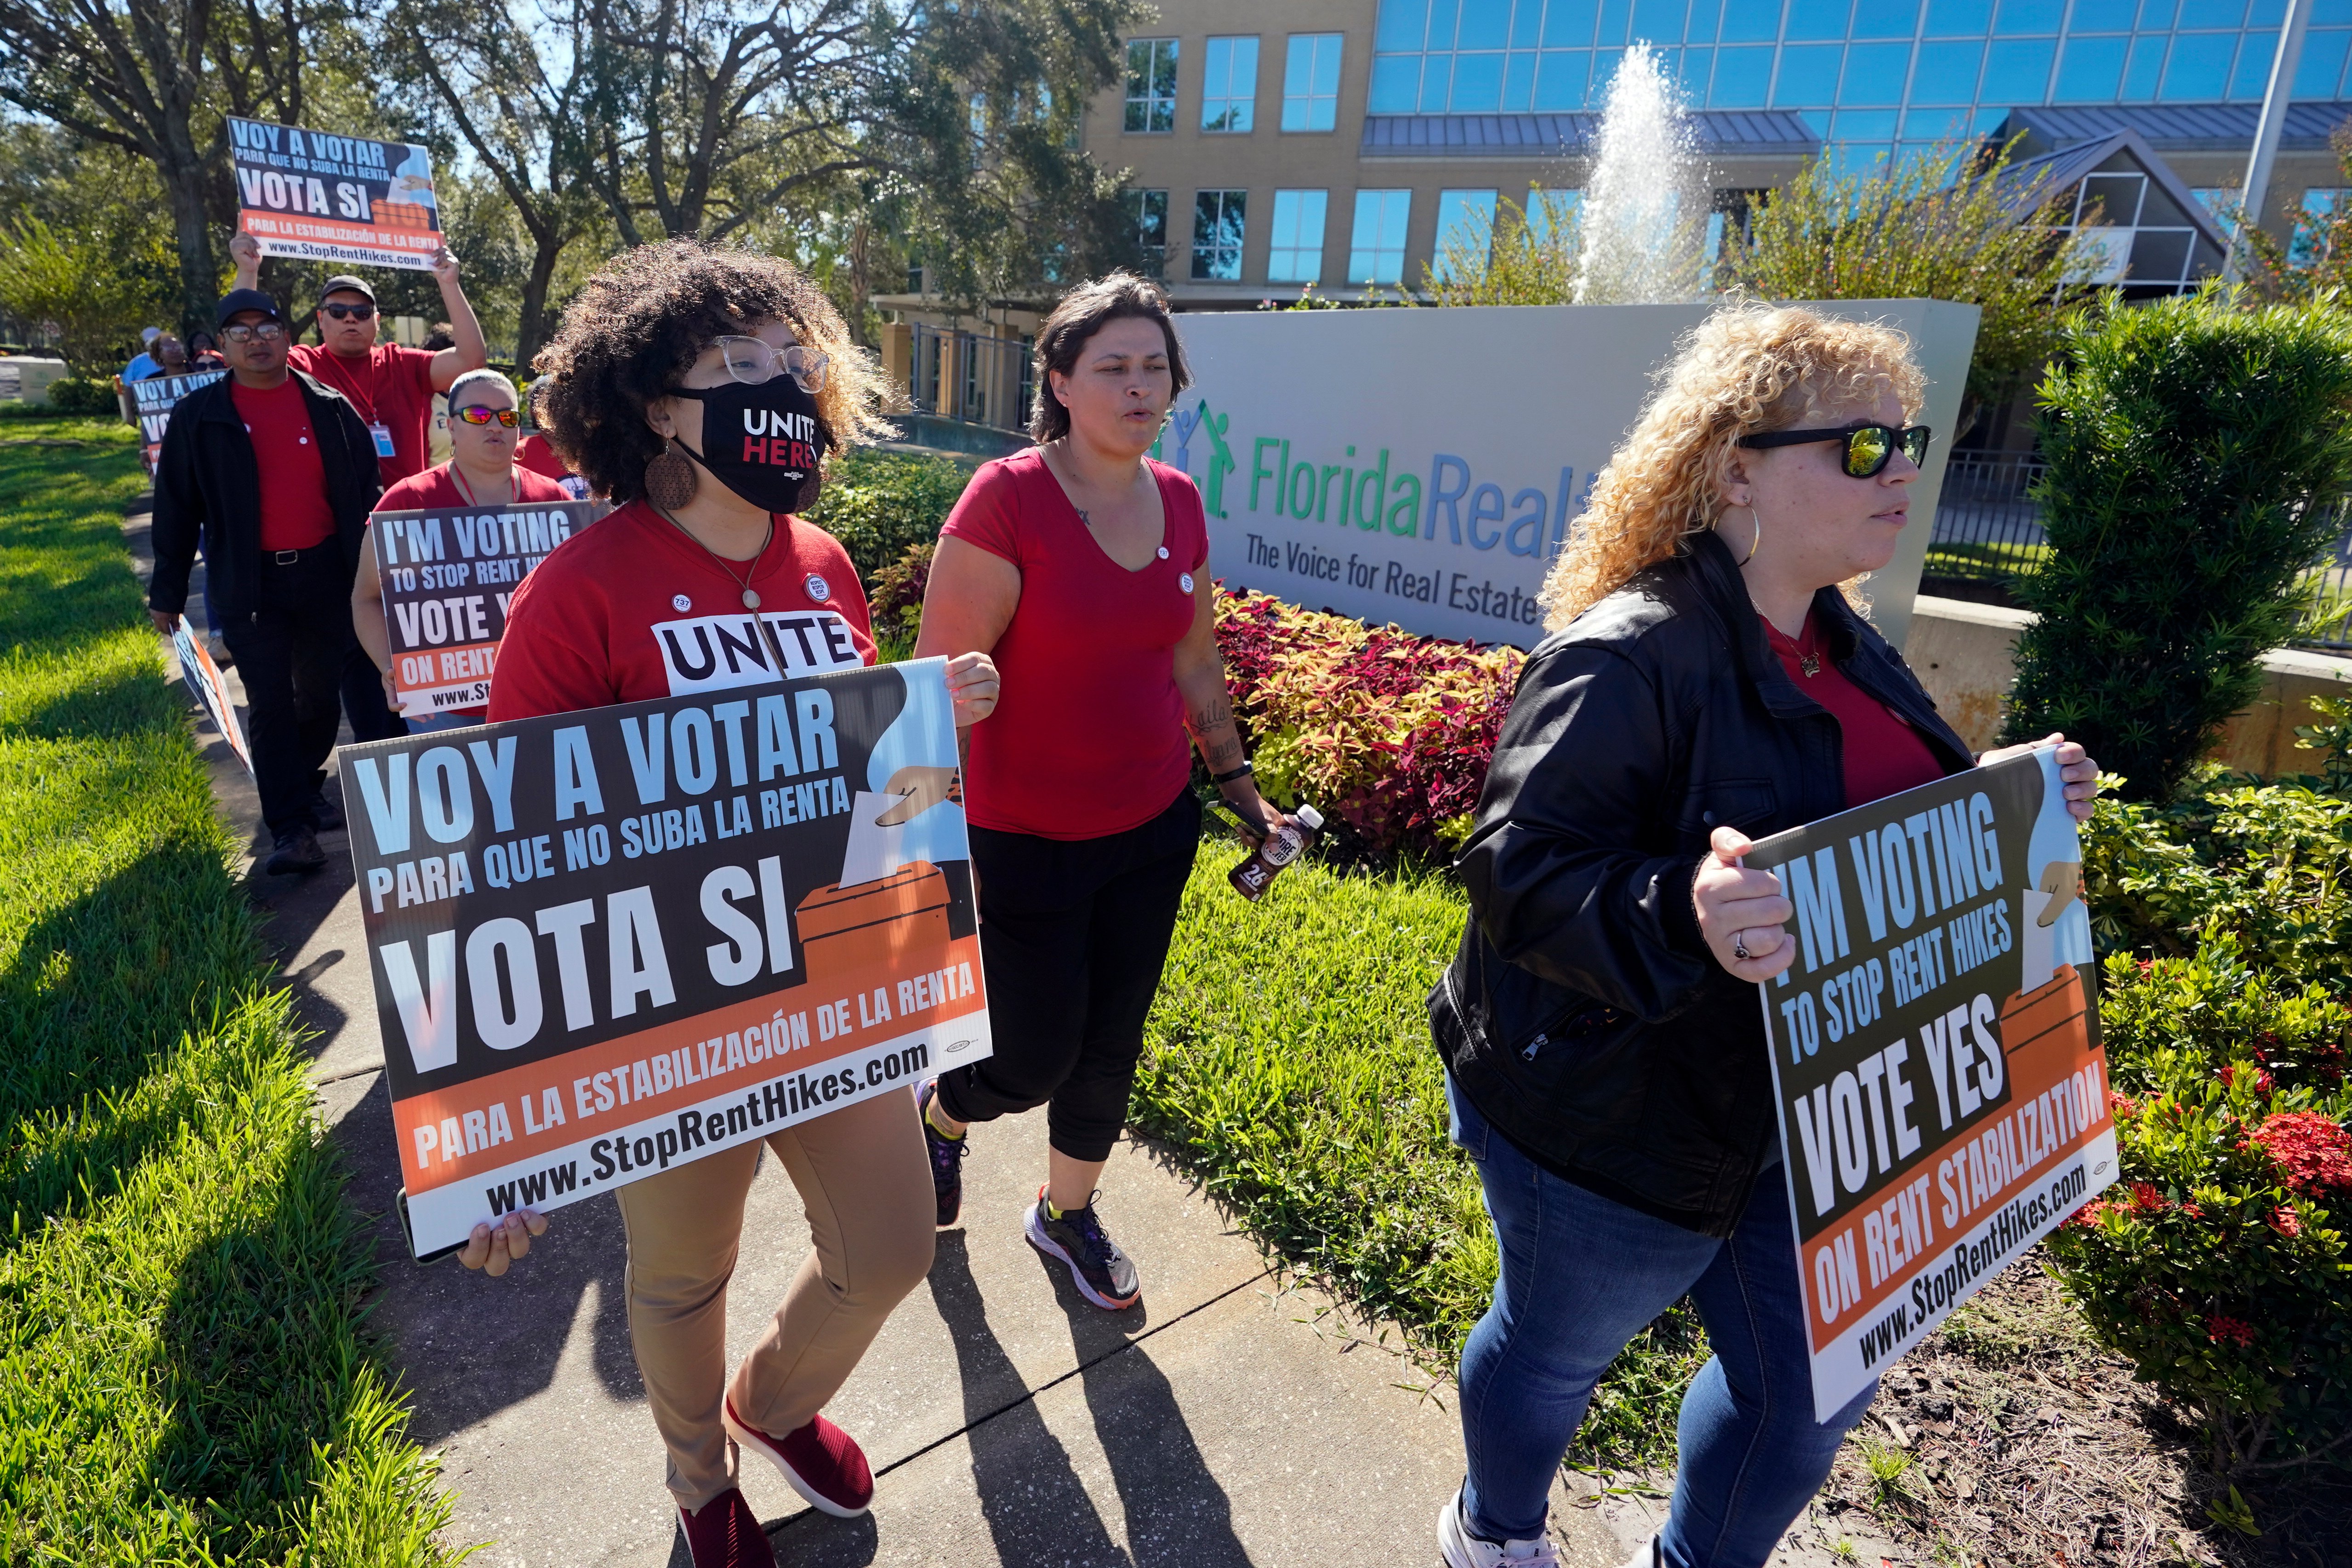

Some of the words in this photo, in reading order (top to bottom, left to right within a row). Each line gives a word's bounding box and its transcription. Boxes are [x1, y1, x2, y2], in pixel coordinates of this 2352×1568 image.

[230, 119, 279, 152] VOY
[290, 130, 306, 156] A
[310, 133, 386, 168] VOTAR
[235, 148, 266, 164] PARA
[268, 154, 290, 168] QUE
[293, 157, 308, 170] NO
[310, 160, 339, 174] SUBA
[342, 165, 355, 177] LA
[357, 166, 391, 182] RENTA
[238, 167, 330, 216] VOTA
[336, 182, 371, 220] SI
[247, 217, 277, 233] PARA
[279, 222, 294, 235] LA
[296, 223, 376, 245] ESTABILIZACIÓN
[378, 233, 392, 246] DE
[394, 234, 407, 247] LA
[410, 236, 439, 250] RENTA
[269, 243, 421, 266] www.StopRentHikes.com
[133, 380, 166, 402] VOY
[171, 378, 184, 398] A
[138, 401, 159, 412] PARA
[744, 409, 814, 444] UNITE
[382, 518, 445, 564] I'M
[453, 510, 571, 558] VOTING
[390, 568, 416, 592] TO
[421, 563, 469, 590] STOP
[475, 558, 520, 584] RENT
[675, 598, 689, 606] 737
[1247, 533, 1280, 570] The
[1287, 541, 1339, 582] Voice
[1347, 553, 1379, 590] for
[1387, 562, 1441, 603] Real
[1448, 573, 1538, 625] Estate
[394, 595, 490, 648] VOTE
[401, 655, 435, 686] ON
[440, 647, 495, 681] RENT
[661, 617, 858, 681] UNITE
[353, 735, 518, 856] VOY
[553, 724, 604, 821] A
[619, 688, 841, 804] VOTAR
[367, 850, 475, 913] PARA
[484, 835, 554, 890] QUE
[564, 823, 611, 872] NO
[622, 804, 707, 857] SUBA
[715, 794, 753, 839] LA
[762, 775, 851, 829] RENTA
[1765, 845, 1851, 988] 'M
[1849, 791, 2003, 944] VOTING
[379, 884, 677, 1074] VOTA
[699, 855, 793, 987] SI
[1780, 990, 1819, 1065] TO
[1822, 958, 1884, 1044] STOP
[1888, 926, 1944, 1009] RENT
[1948, 898, 2013, 977] HIKES
[413, 1103, 513, 1170] PARA
[522, 1086, 565, 1136] LA
[572, 1007, 810, 1120] ESTABILIZACIÓN
[819, 997, 853, 1039] DE
[858, 986, 891, 1027] LA
[897, 961, 975, 1014] RENTA
[485, 1042, 929, 1217] www.StopRentHikes.com
[1794, 1037, 1921, 1217] VOTE
[1919, 992, 2004, 1132] YES
[1815, 1227, 1861, 1325] ON
[1863, 1172, 1934, 1290] RENT
[1937, 1060, 2105, 1230] STABILIZATION
[1860, 1163, 2087, 1370] www.StopRentHikes.com
